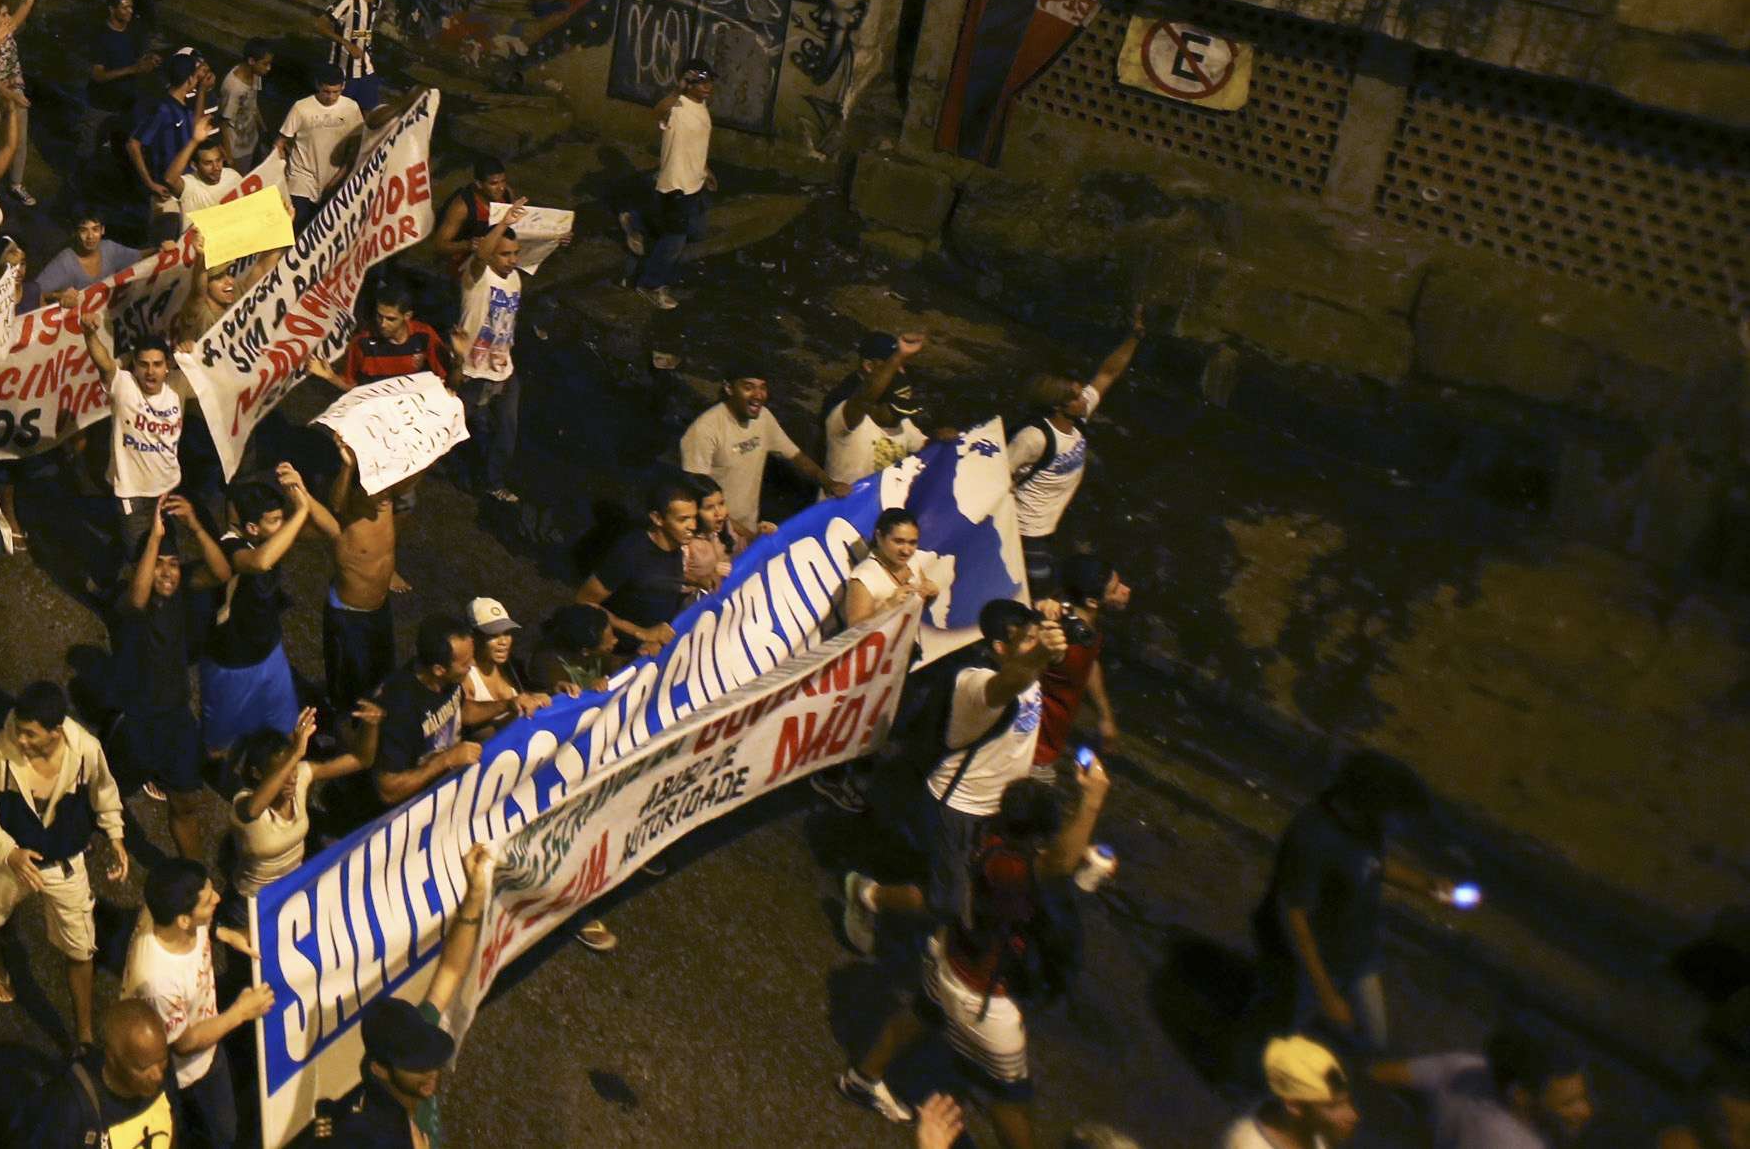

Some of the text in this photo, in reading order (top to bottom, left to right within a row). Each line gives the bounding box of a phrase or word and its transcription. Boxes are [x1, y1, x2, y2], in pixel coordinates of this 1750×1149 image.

[1172, 31, 1212, 82] E
[229, 317, 269, 373] SIM
[764, 686, 892, 786] NÃO!
[277, 729, 559, 1063] SALVEMOS
[657, 516, 868, 730] CONRADO
